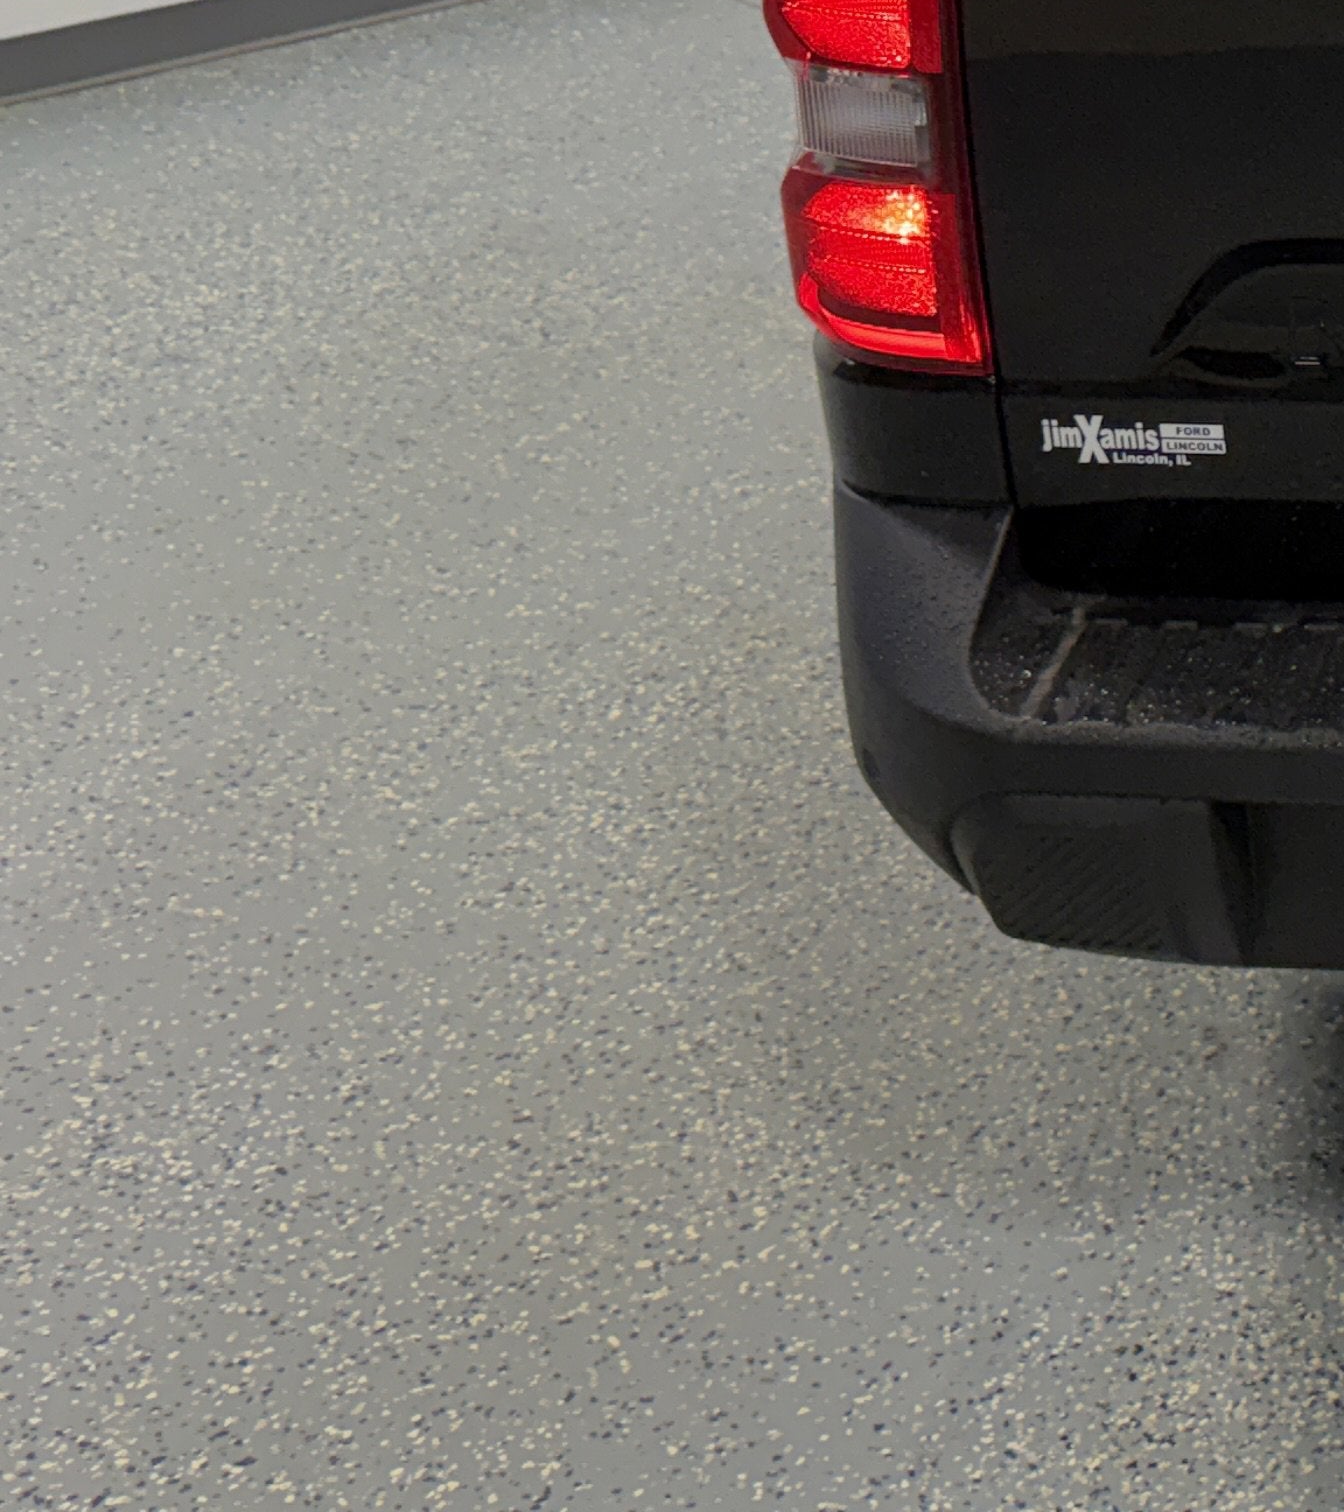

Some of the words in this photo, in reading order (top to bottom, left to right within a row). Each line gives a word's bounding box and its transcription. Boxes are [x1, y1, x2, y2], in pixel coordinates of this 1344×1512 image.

[1175, 426, 1212, 437] FORD
[1166, 440, 1224, 452] LINCOLN
[1112, 453, 1174, 467] Lincoln,
[1175, 454, 1193, 467] IL
